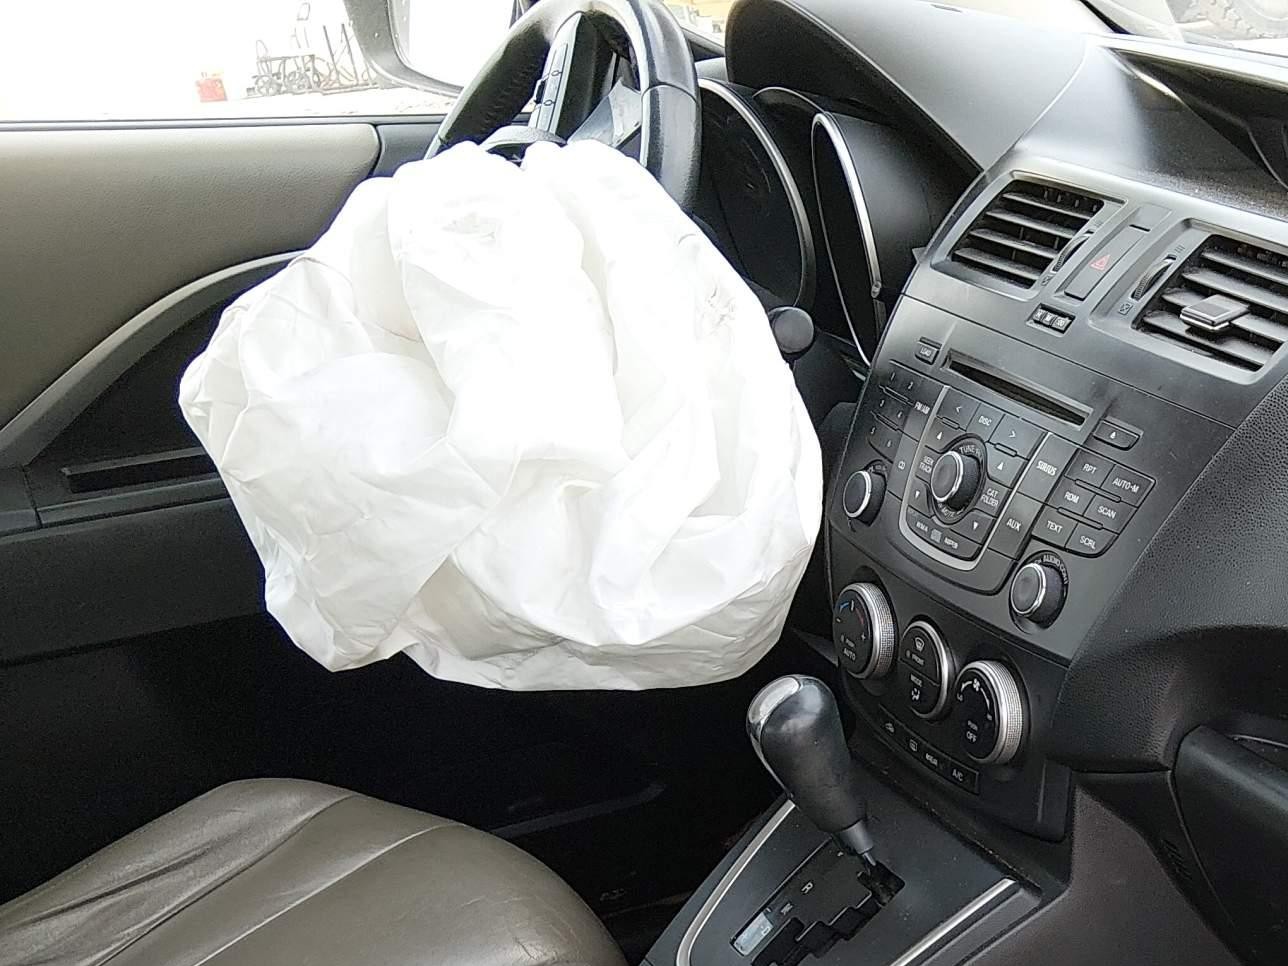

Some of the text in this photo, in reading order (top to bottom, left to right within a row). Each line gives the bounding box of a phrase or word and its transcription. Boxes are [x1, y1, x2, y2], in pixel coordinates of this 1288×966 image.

[977, 415, 992, 426] DISC
[1036, 459, 1057, 476] SIRIUS
[1082, 463, 1097, 475] RPT
[1112, 477, 1140, 493] AUTO-M
[987, 487, 998, 498] CAT
[1064, 491, 1080, 504] RDM
[980, 494, 999, 508] FOLDER
[1097, 505, 1117, 519] SCAN
[1006, 518, 1022, 531] AUX
[1046, 520, 1063, 534] TEXT
[1079, 535, 1096, 550] SCRL
[952, 768, 963, 781] A/C
[801, 882, 814, 894] R
